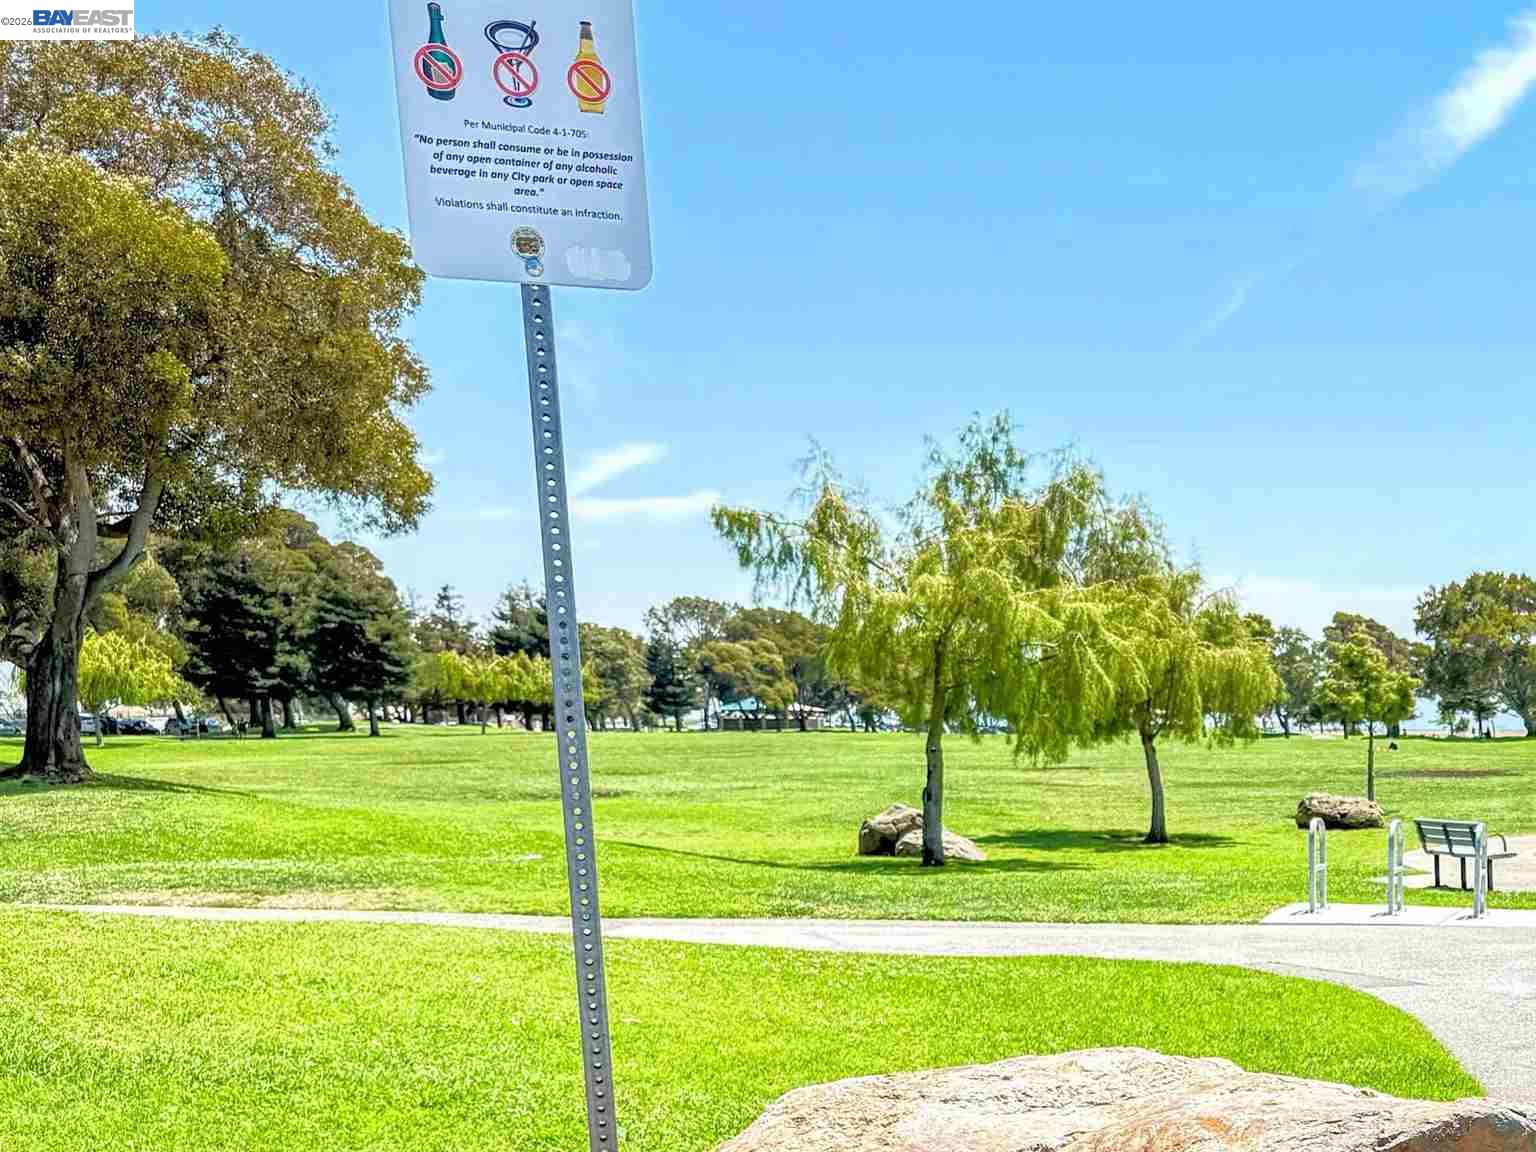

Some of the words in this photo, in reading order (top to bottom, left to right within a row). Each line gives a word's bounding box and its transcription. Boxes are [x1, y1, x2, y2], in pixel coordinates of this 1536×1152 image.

[464, 119, 480, 129] Per
[481, 120, 526, 133] Municipal
[528, 124, 551, 136] Code
[552, 128, 587, 138] 4-1-705
[433, 150, 444, 162] of
[446, 153, 464, 163] any
[467, 155, 492, 165] open
[494, 157, 541, 169] container
[543, 160, 553, 171] of
[555, 163, 573, 173] any
[576, 163, 618, 175] alcoholic
[436, 138, 470, 147] person
[473, 140, 496, 150] shall
[498, 143, 541, 154] consume
[544, 147, 554, 155] or
[557, 146, 569, 157] be
[571, 148, 580, 158] in
[583, 151, 633, 162] possession
[430, 164, 476, 178] beverage
[480, 168, 488, 178] in
[491, 171, 509, 182] any
[512, 171, 530, 184] City
[533, 174, 554, 185] park
[570, 178, 594, 188] open
[596, 180, 624, 189] space
[435, 196, 484, 210] Violations
[486, 202, 508, 212] shall
[511, 204, 559, 216] constitute
[561, 209, 573, 217] an
[576, 208, 623, 221] infraction.
